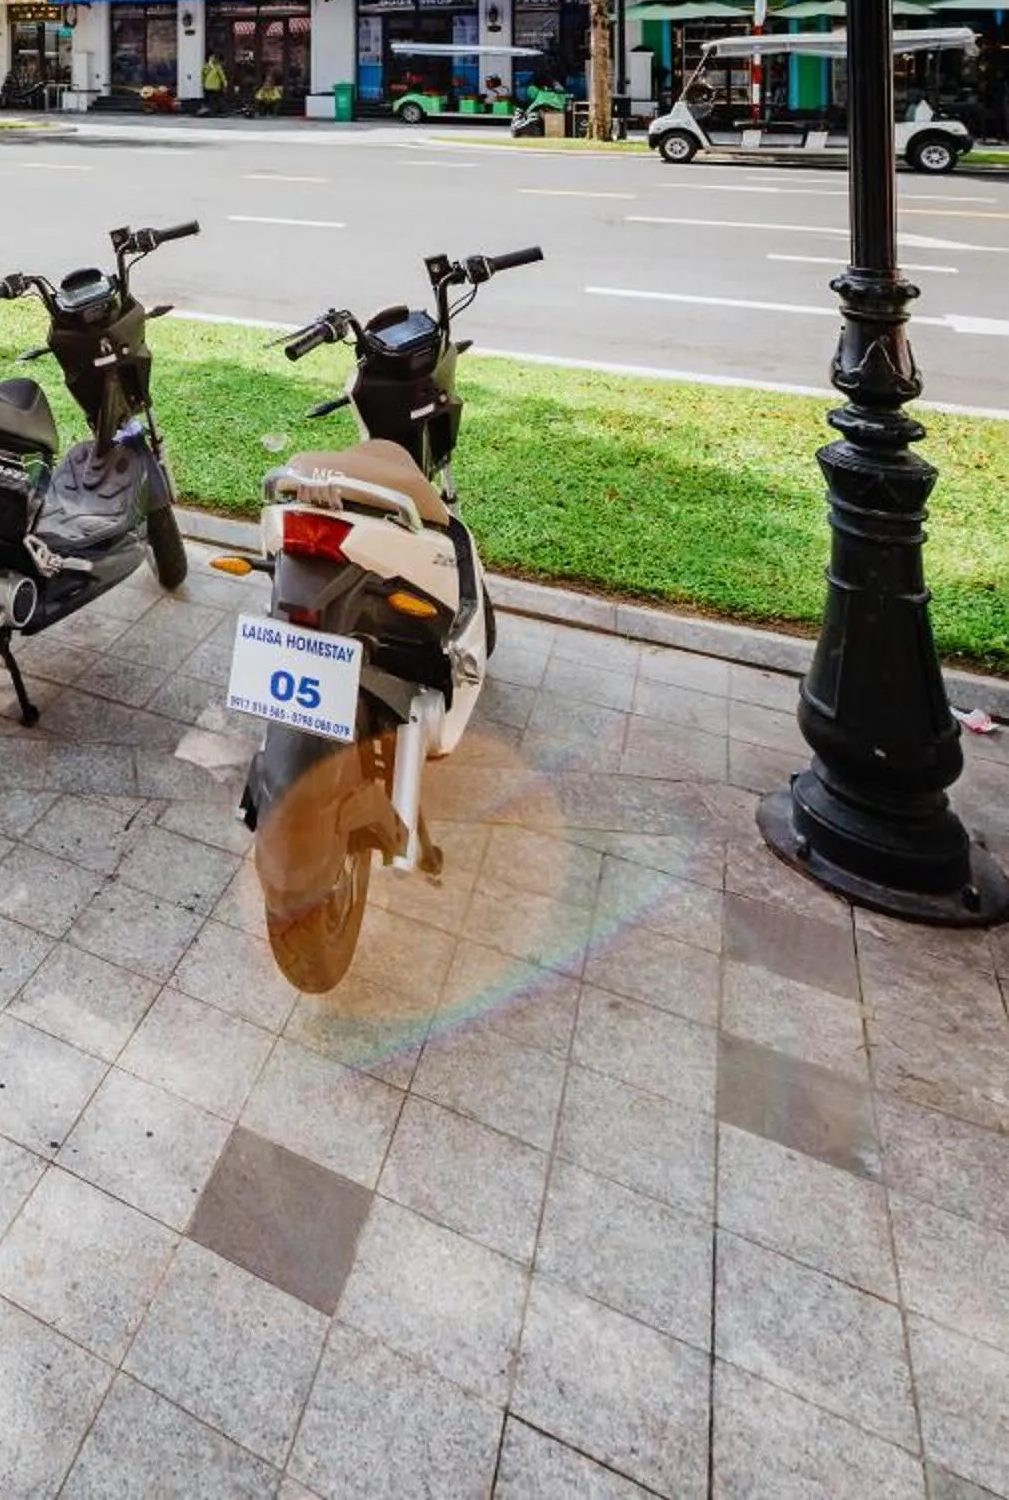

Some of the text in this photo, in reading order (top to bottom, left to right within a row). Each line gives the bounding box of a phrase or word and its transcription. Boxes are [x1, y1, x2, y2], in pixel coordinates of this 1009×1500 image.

[242, 623, 355, 663] LALISA HOMESTAY
[270, 670, 321, 709] 05
